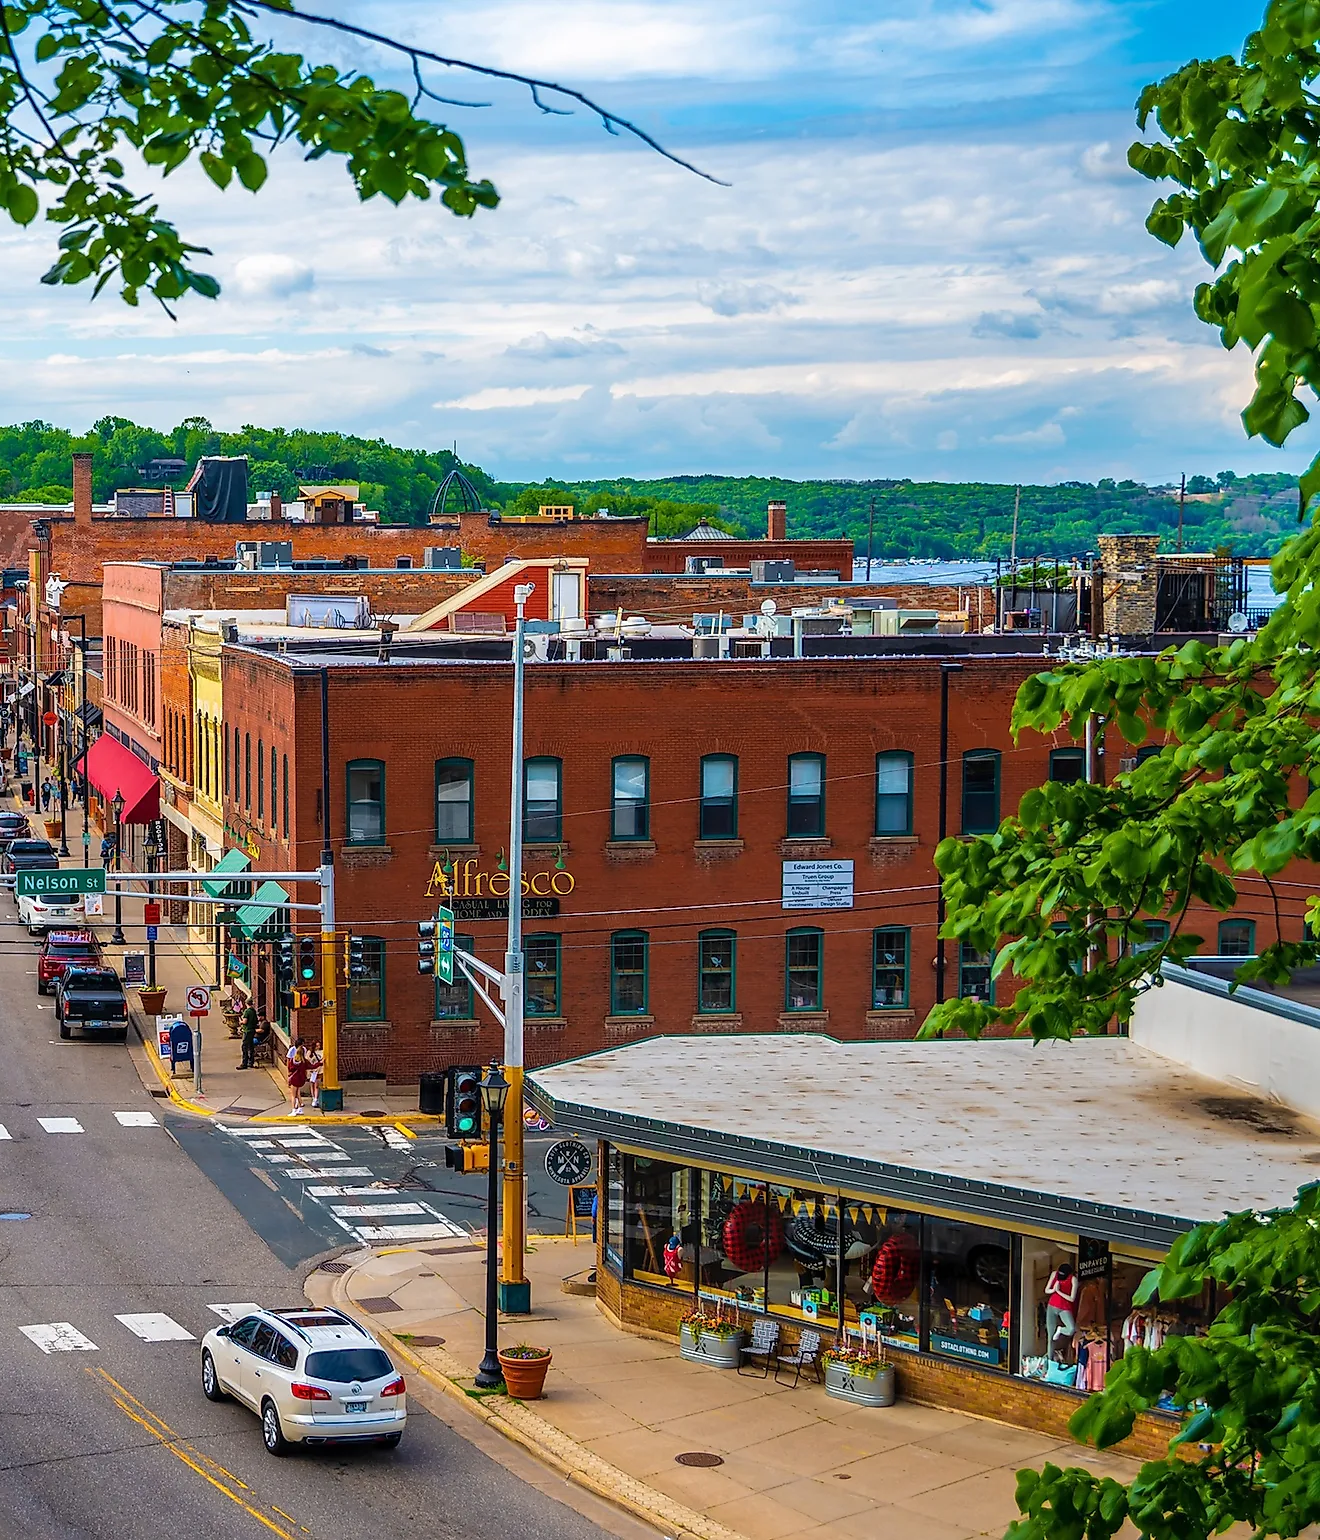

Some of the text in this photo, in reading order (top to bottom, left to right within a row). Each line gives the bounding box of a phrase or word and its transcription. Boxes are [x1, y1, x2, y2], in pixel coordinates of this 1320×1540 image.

[24, 875, 99, 890] Nelson St
[423, 858, 575, 897] Alfresco
[452, 899, 489, 909] CASUAL
[1079, 1256, 1108, 1270] UNPAVED
[940, 1340, 990, 1359] SOTACLOTHING.COM
